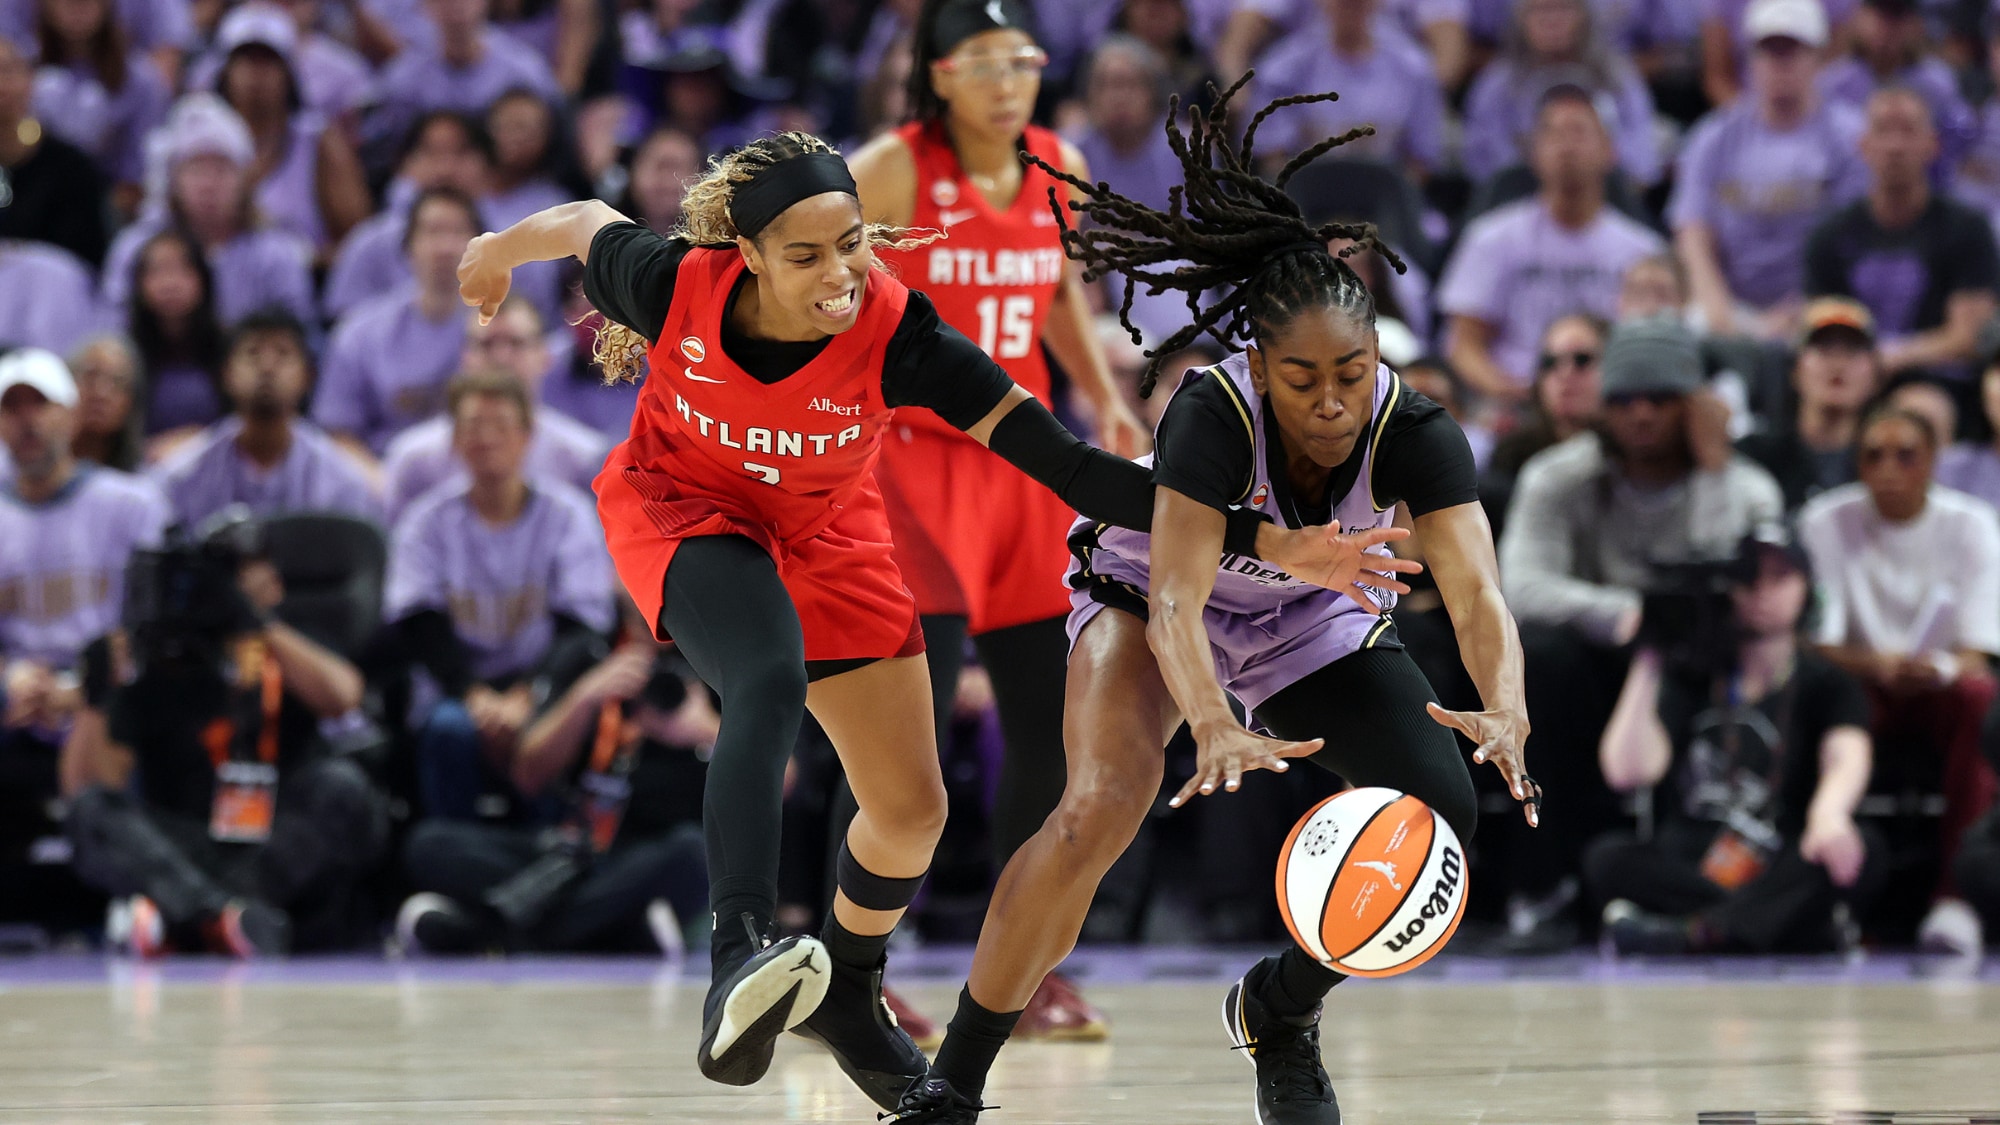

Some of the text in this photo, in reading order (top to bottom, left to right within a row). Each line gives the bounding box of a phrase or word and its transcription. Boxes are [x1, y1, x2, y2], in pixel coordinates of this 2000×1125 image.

[928, 248, 1063, 286] ATLANTA
[976, 295, 1035, 359] 15
[675, 393, 862, 458] ATLANTA
[807, 396, 862, 416] Albert
[1219, 553, 1293, 582] LDEN
[1382, 845, 1461, 953] Wilson
